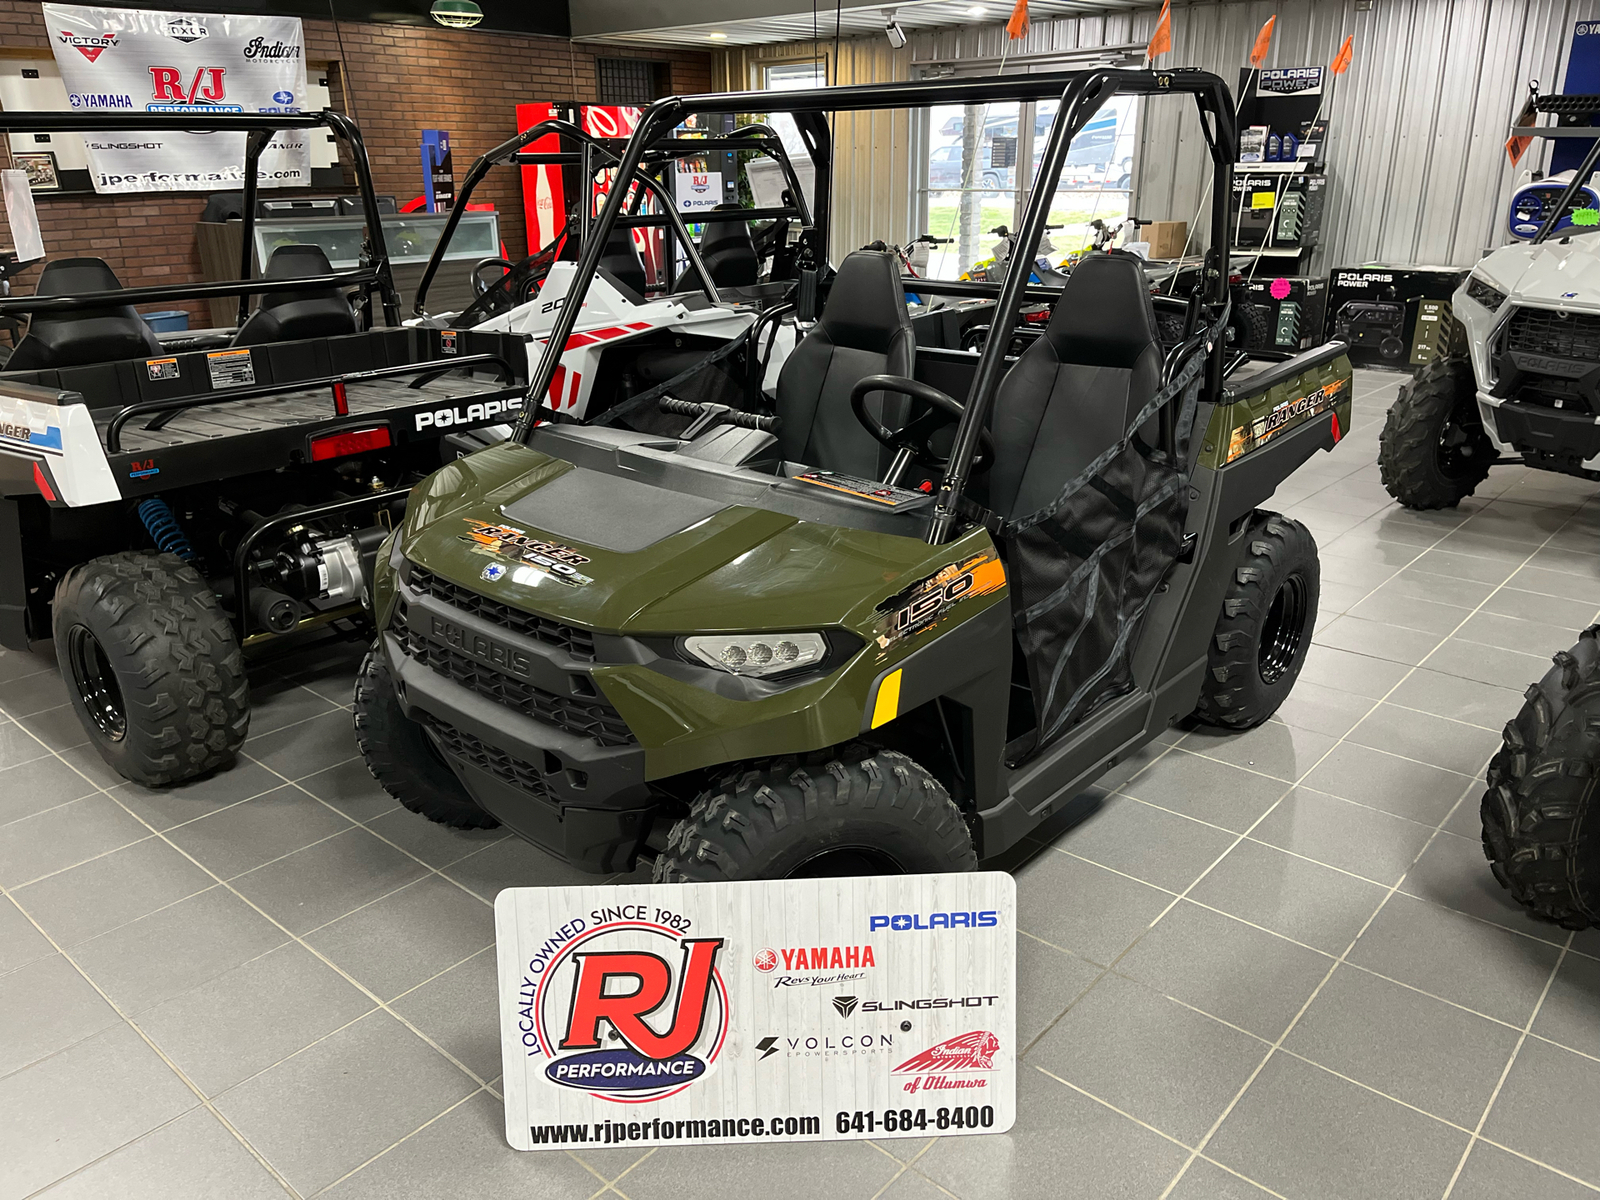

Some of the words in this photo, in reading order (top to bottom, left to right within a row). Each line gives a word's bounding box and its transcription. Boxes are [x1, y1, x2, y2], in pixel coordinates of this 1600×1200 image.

[58, 36, 120, 47] VICTORY
[243, 36, 300, 58] Indian
[1261, 69, 1319, 80] POLARIS
[1261, 79, 1318, 88] POWER
[82, 95, 133, 108] YAMAHA
[91, 142, 164, 150] SLINGSHOT
[692, 176, 708, 185] R/J
[1338, 273, 1393, 282] POLARIS
[415, 397, 523, 431] POLARIS
[1266, 388, 1325, 432] RANGER
[473, 526, 591, 566] RANGER
[521, 552, 576, 575] 150
[898, 572, 974, 630] 150
[431, 616, 532, 678] POLARIS
[870, 911, 998, 932] POLARIS
[781, 945, 875, 971] YAMAHA
[518, 976, 542, 1057] LOCALLY
[530, 918, 586, 974] OWNED
[591, 905, 647, 926] SINCE
[654, 908, 692, 934] 1982
[774, 976, 810, 989] Revs
[810, 974, 837, 987] Your
[558, 937, 725, 1061] RJ
[861, 996, 999, 1012] SLINGSHOT
[787, 1034, 893, 1050] VOLCON
[931, 1044, 972, 1056] Indian
[787, 1048, 893, 1058] EPOWERSPORTS
[556, 1060, 695, 1079] PERFORMANCE
[903, 1076, 922, 1094] of
[922, 1075, 988, 1090] Ottumwa
[531, 1113, 821, 1144] www.rjperformance.com
[836, 1105, 994, 1134] 641-684-8400
